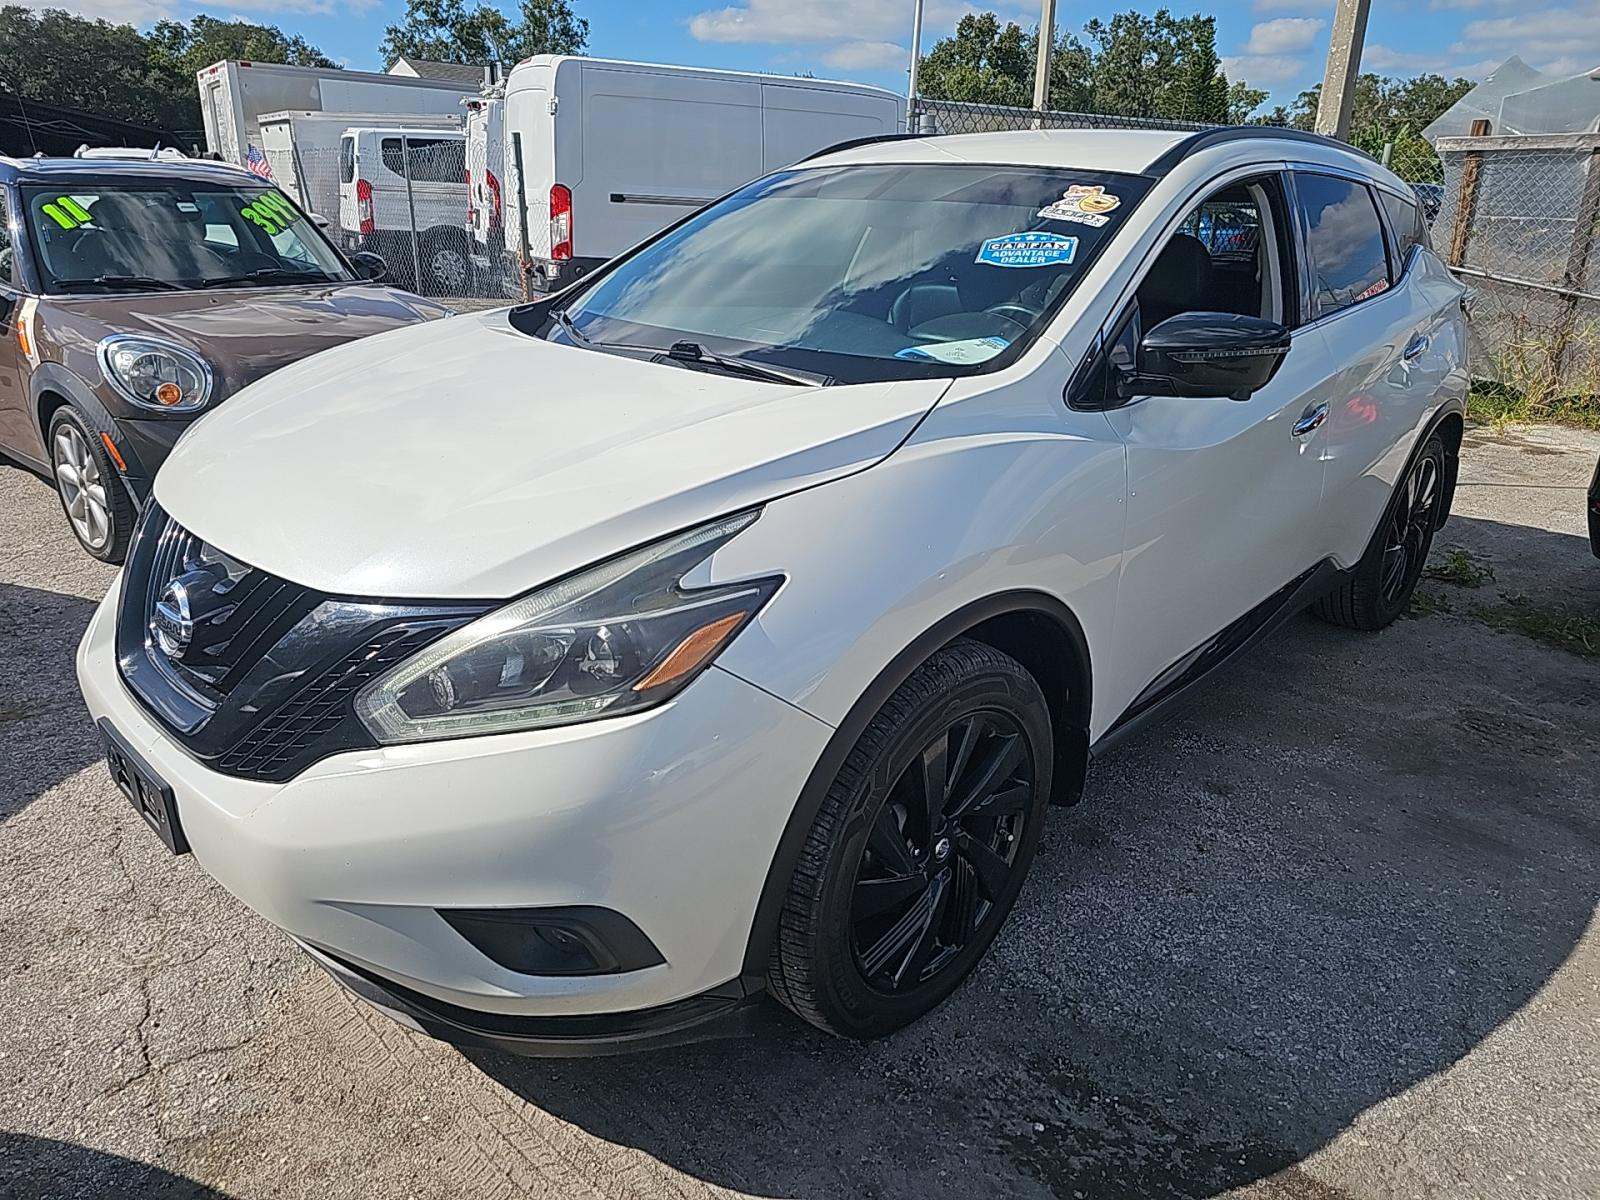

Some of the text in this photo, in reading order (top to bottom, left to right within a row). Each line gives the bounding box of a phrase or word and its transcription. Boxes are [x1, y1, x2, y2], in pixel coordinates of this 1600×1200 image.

[41, 196, 94, 231] 11
[241, 190, 300, 235] 3999
[989, 241, 1069, 251] CARFAX
[991, 249, 1061, 258] ADVANTAGE
